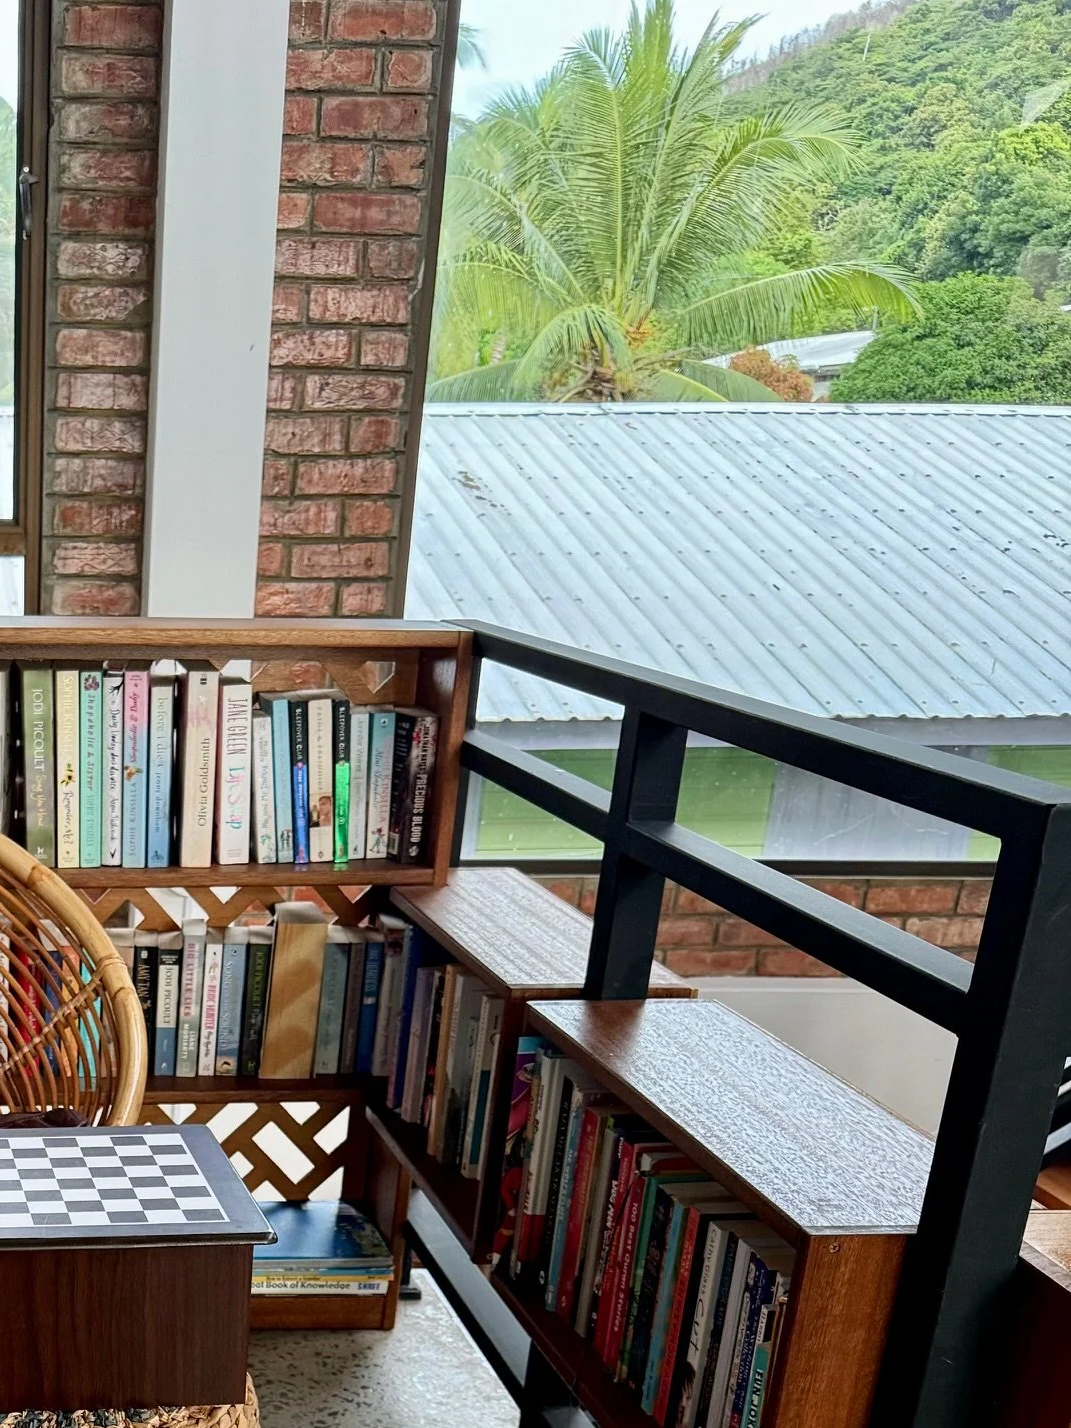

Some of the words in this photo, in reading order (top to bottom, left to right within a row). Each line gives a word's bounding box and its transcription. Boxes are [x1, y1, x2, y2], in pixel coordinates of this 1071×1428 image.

[32, 688, 45, 715] JODI
[62, 676, 75, 711] SOPHIE
[85, 694, 96, 749] Shopaholic
[156, 697, 167, 732] before
[227, 698, 249, 724] JANE
[32, 720, 45, 772] PICOULT
[226, 725, 247, 756] GREEN
[85, 761, 96, 791] Sister
[199, 737, 210, 794] Goldsmith
[153, 771, 163, 794] jenny
[413, 774, 428, 814] PRECIOUS
[128, 781, 137, 823] KINSELLA
[197, 795, 208, 827] Olivia
[378, 774, 391, 824] KINSELLA
[128, 826, 138, 857] SOPHIE
[409, 816, 422, 843] BLOOD
[187, 943, 196, 960] BIG
[137, 964, 151, 981] AMY
[165, 967, 174, 987] JODI
[185, 963, 195, 995] LITTLE
[223, 960, 233, 987] SONG
[138, 982, 150, 998] TAN
[162, 989, 174, 1025] PICOULT
[183, 996, 193, 1018] LIES
[204, 1004, 216, 1031] HUNTER
[181, 1023, 190, 1060] MORIARTY
[188, 1030, 196, 1051] LIANE
[609, 1180, 619, 1204] DOG
[606, 1203, 616, 1229] MAN
[630, 1202, 639, 1222] 100
[626, 1224, 635, 1250] Best
[621, 1253, 631, 1289] Quran
[266, 1281, 288, 1289] Book
[290, 1281, 299, 1289] of
[300, 1281, 351, 1290] Knowledge
[614, 1291, 625, 1333] Stories
[690, 1298, 705, 1356] Cut
[751, 1369, 765, 1396] FUN
